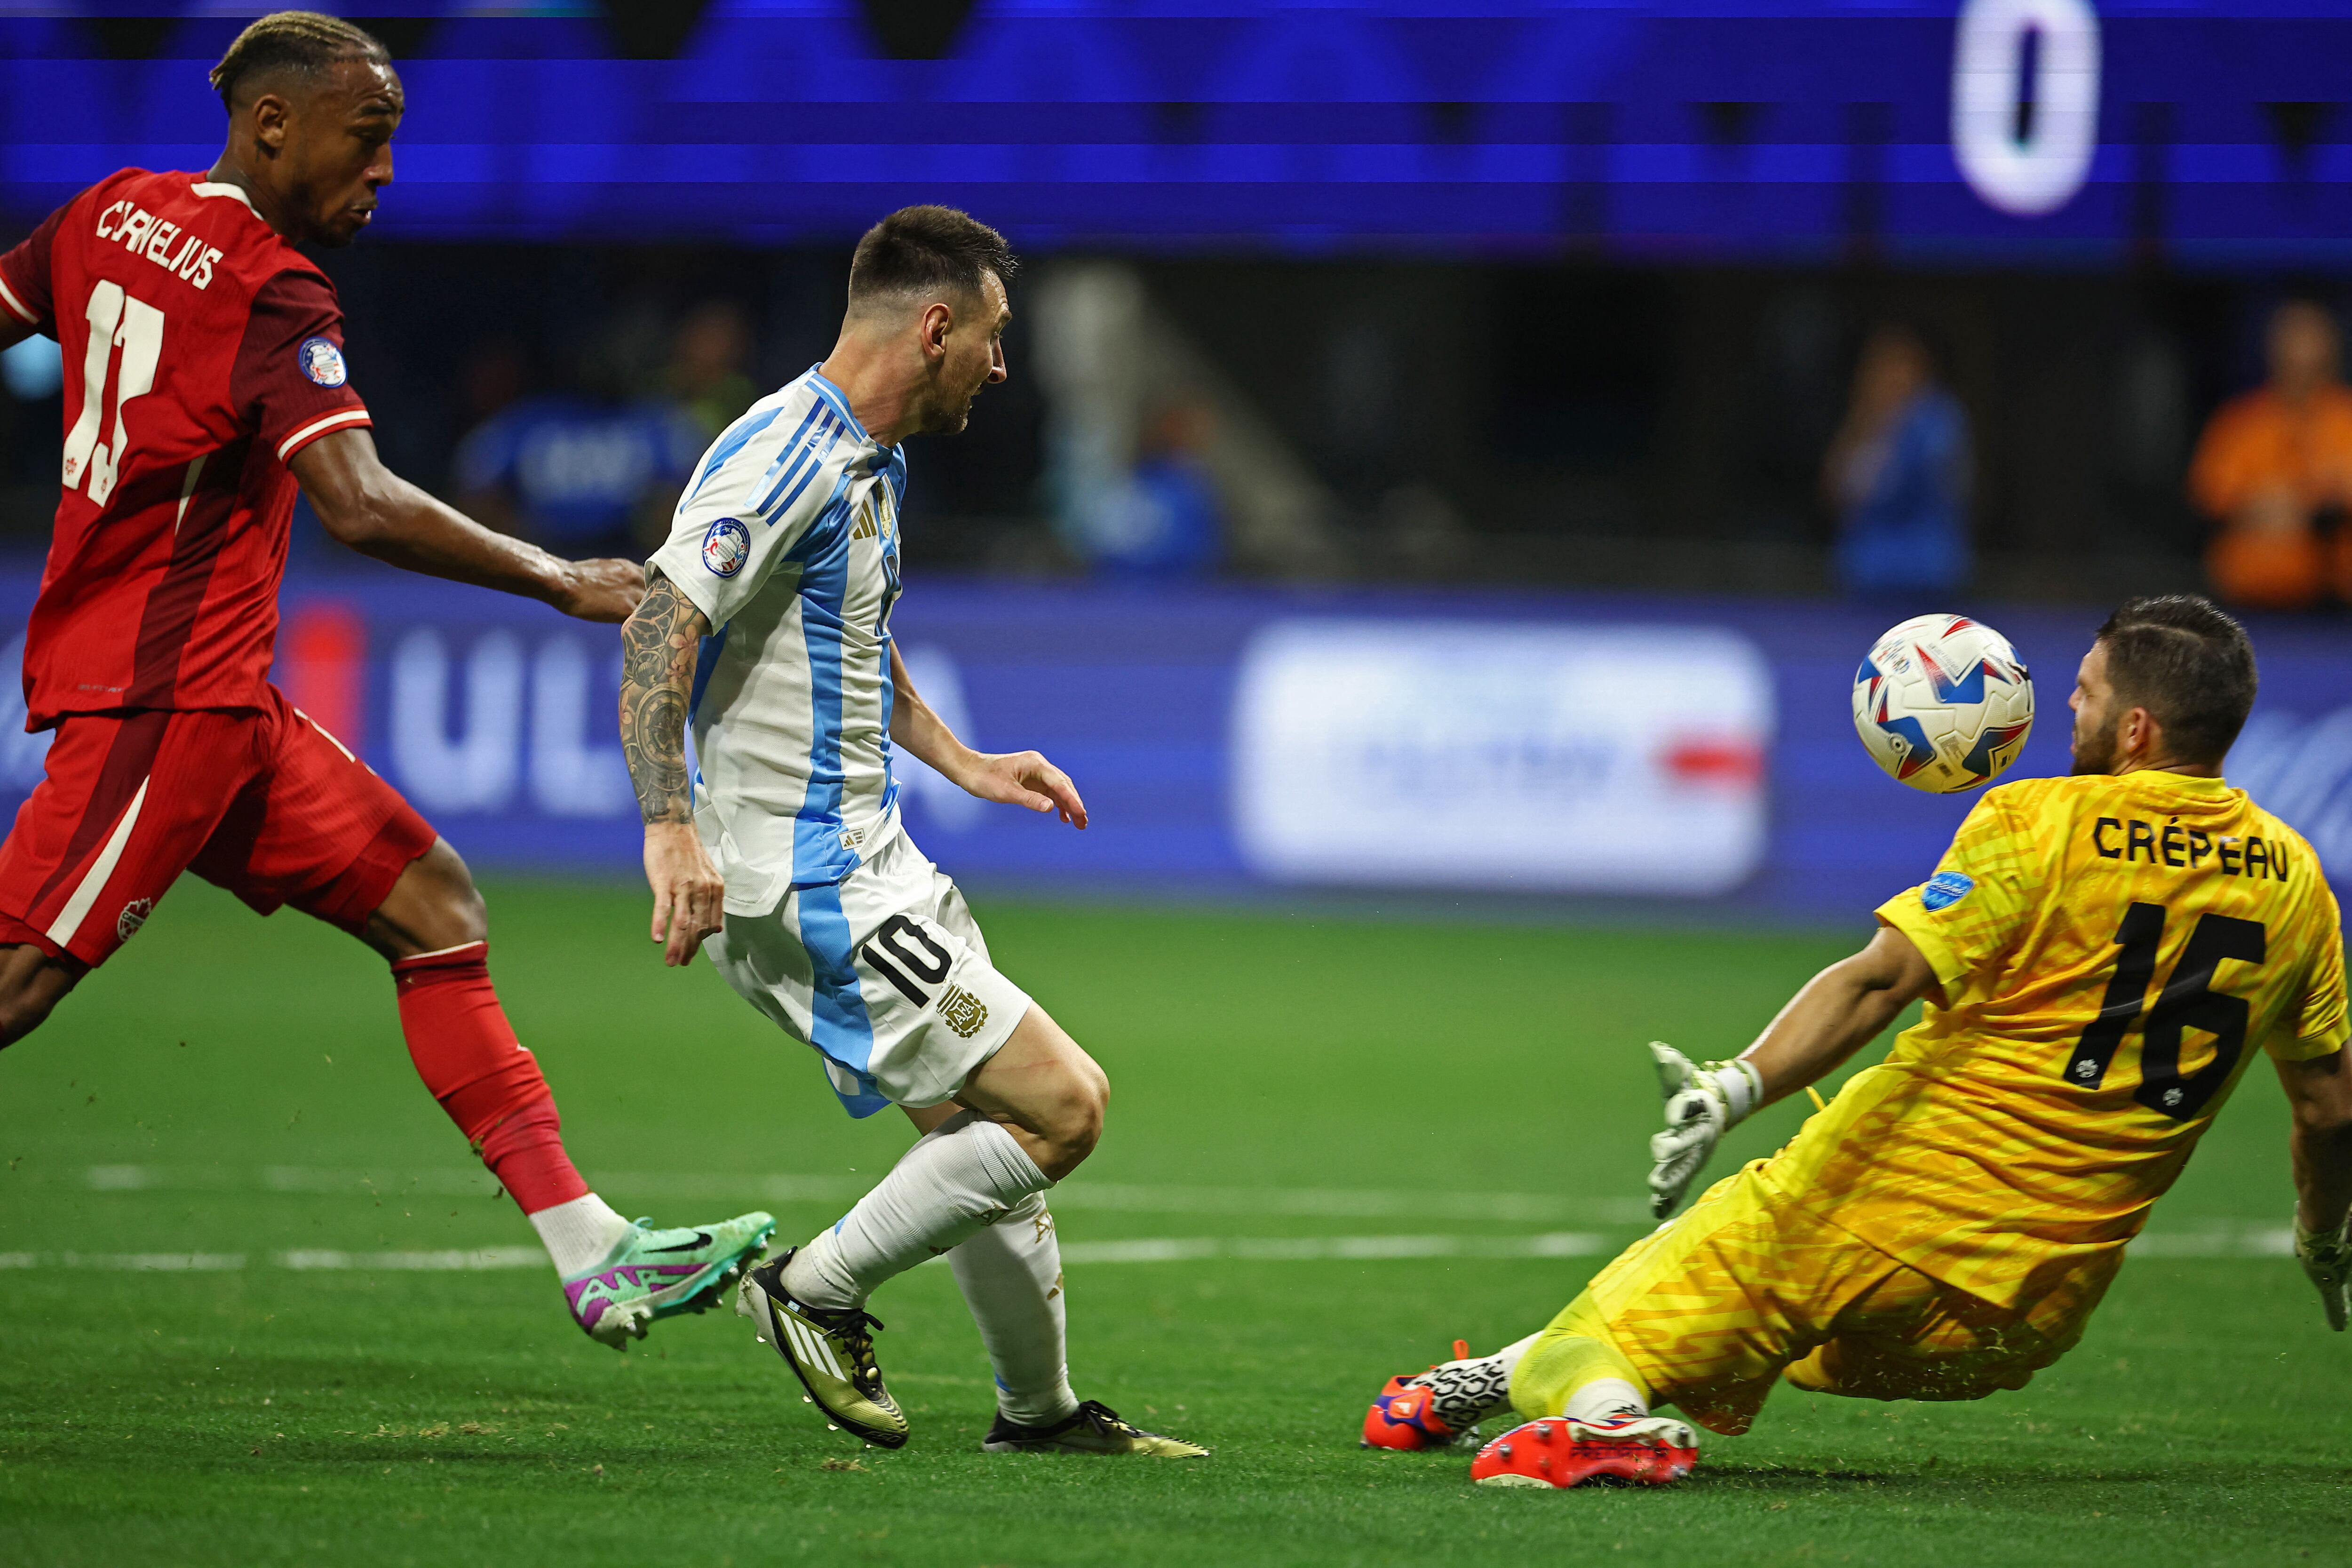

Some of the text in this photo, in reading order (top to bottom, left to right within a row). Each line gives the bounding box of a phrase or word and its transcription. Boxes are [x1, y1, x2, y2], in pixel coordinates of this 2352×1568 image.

[2093, 816, 2287, 882] CRÉPEAU
[862, 915, 952, 1009] 10
[949, 999, 975, 1026] AFA
[2063, 902, 2266, 1122] 16
